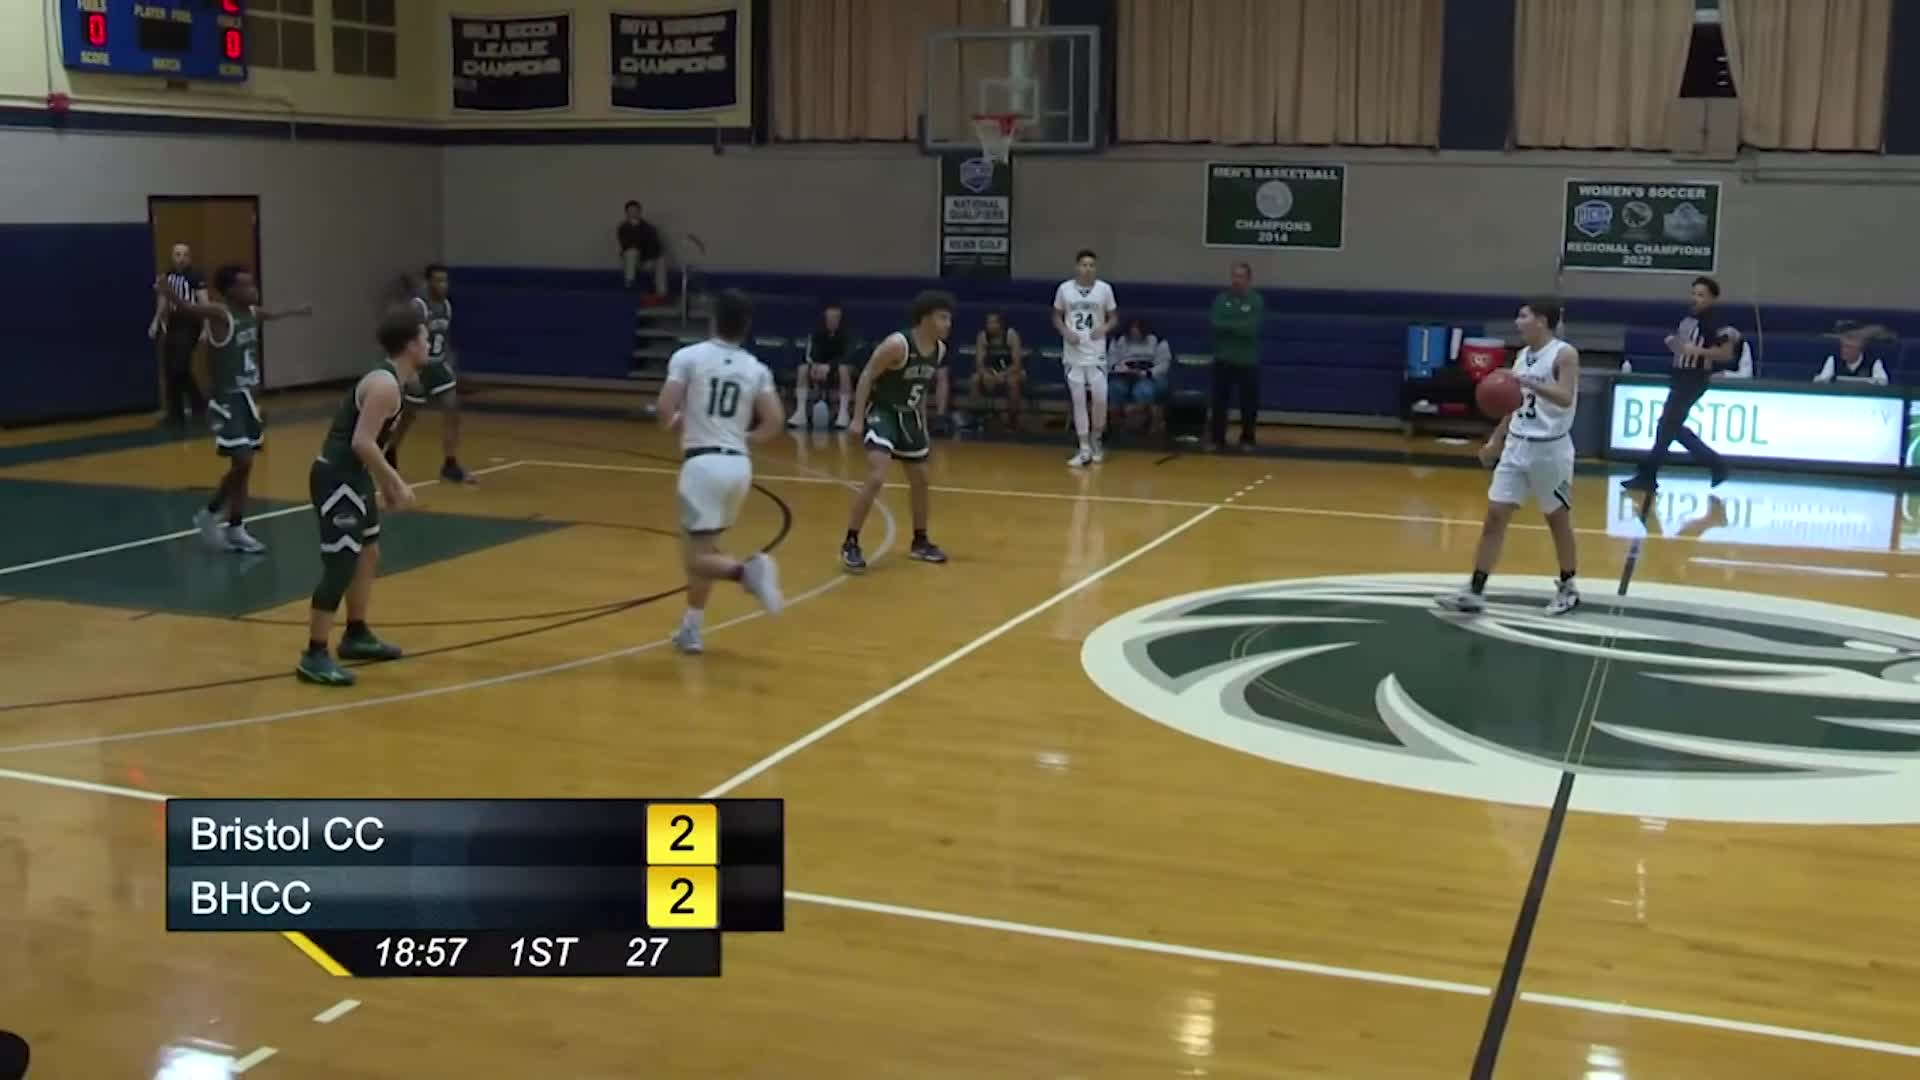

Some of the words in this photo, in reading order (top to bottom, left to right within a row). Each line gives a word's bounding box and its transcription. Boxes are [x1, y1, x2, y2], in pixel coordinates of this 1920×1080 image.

[89, 13, 106, 46] 0
[226, 29, 241, 59] 0
[473, 41, 548, 58] LEAGUE
[632, 36, 713, 54] LEAGUE
[462, 57, 560, 76] CHAMPIONS
[620, 55, 726, 74] CHAMPIONS
[1254, 168, 1337, 181] BASKETBALL
[1579, 185, 1645, 198] WOMEN'S
[1648, 186, 1706, 200] SOCCER
[953, 199, 1000, 208] NATIONAL
[949, 208, 1004, 219] QUALIFIERS
[1235, 219, 1312, 231] CHAMPIONS
[979, 240, 1002, 249] GOLF
[1258, 231, 1289, 242] 2014
[1567, 241, 1632, 254] REGIONAL
[1634, 243, 1712, 256] CHAMPIONS
[1075, 312, 1093, 330] 24
[708, 377, 741, 418] 10
[907, 384, 924, 408] 5
[1623, 398, 1768, 445] BRSTOL
